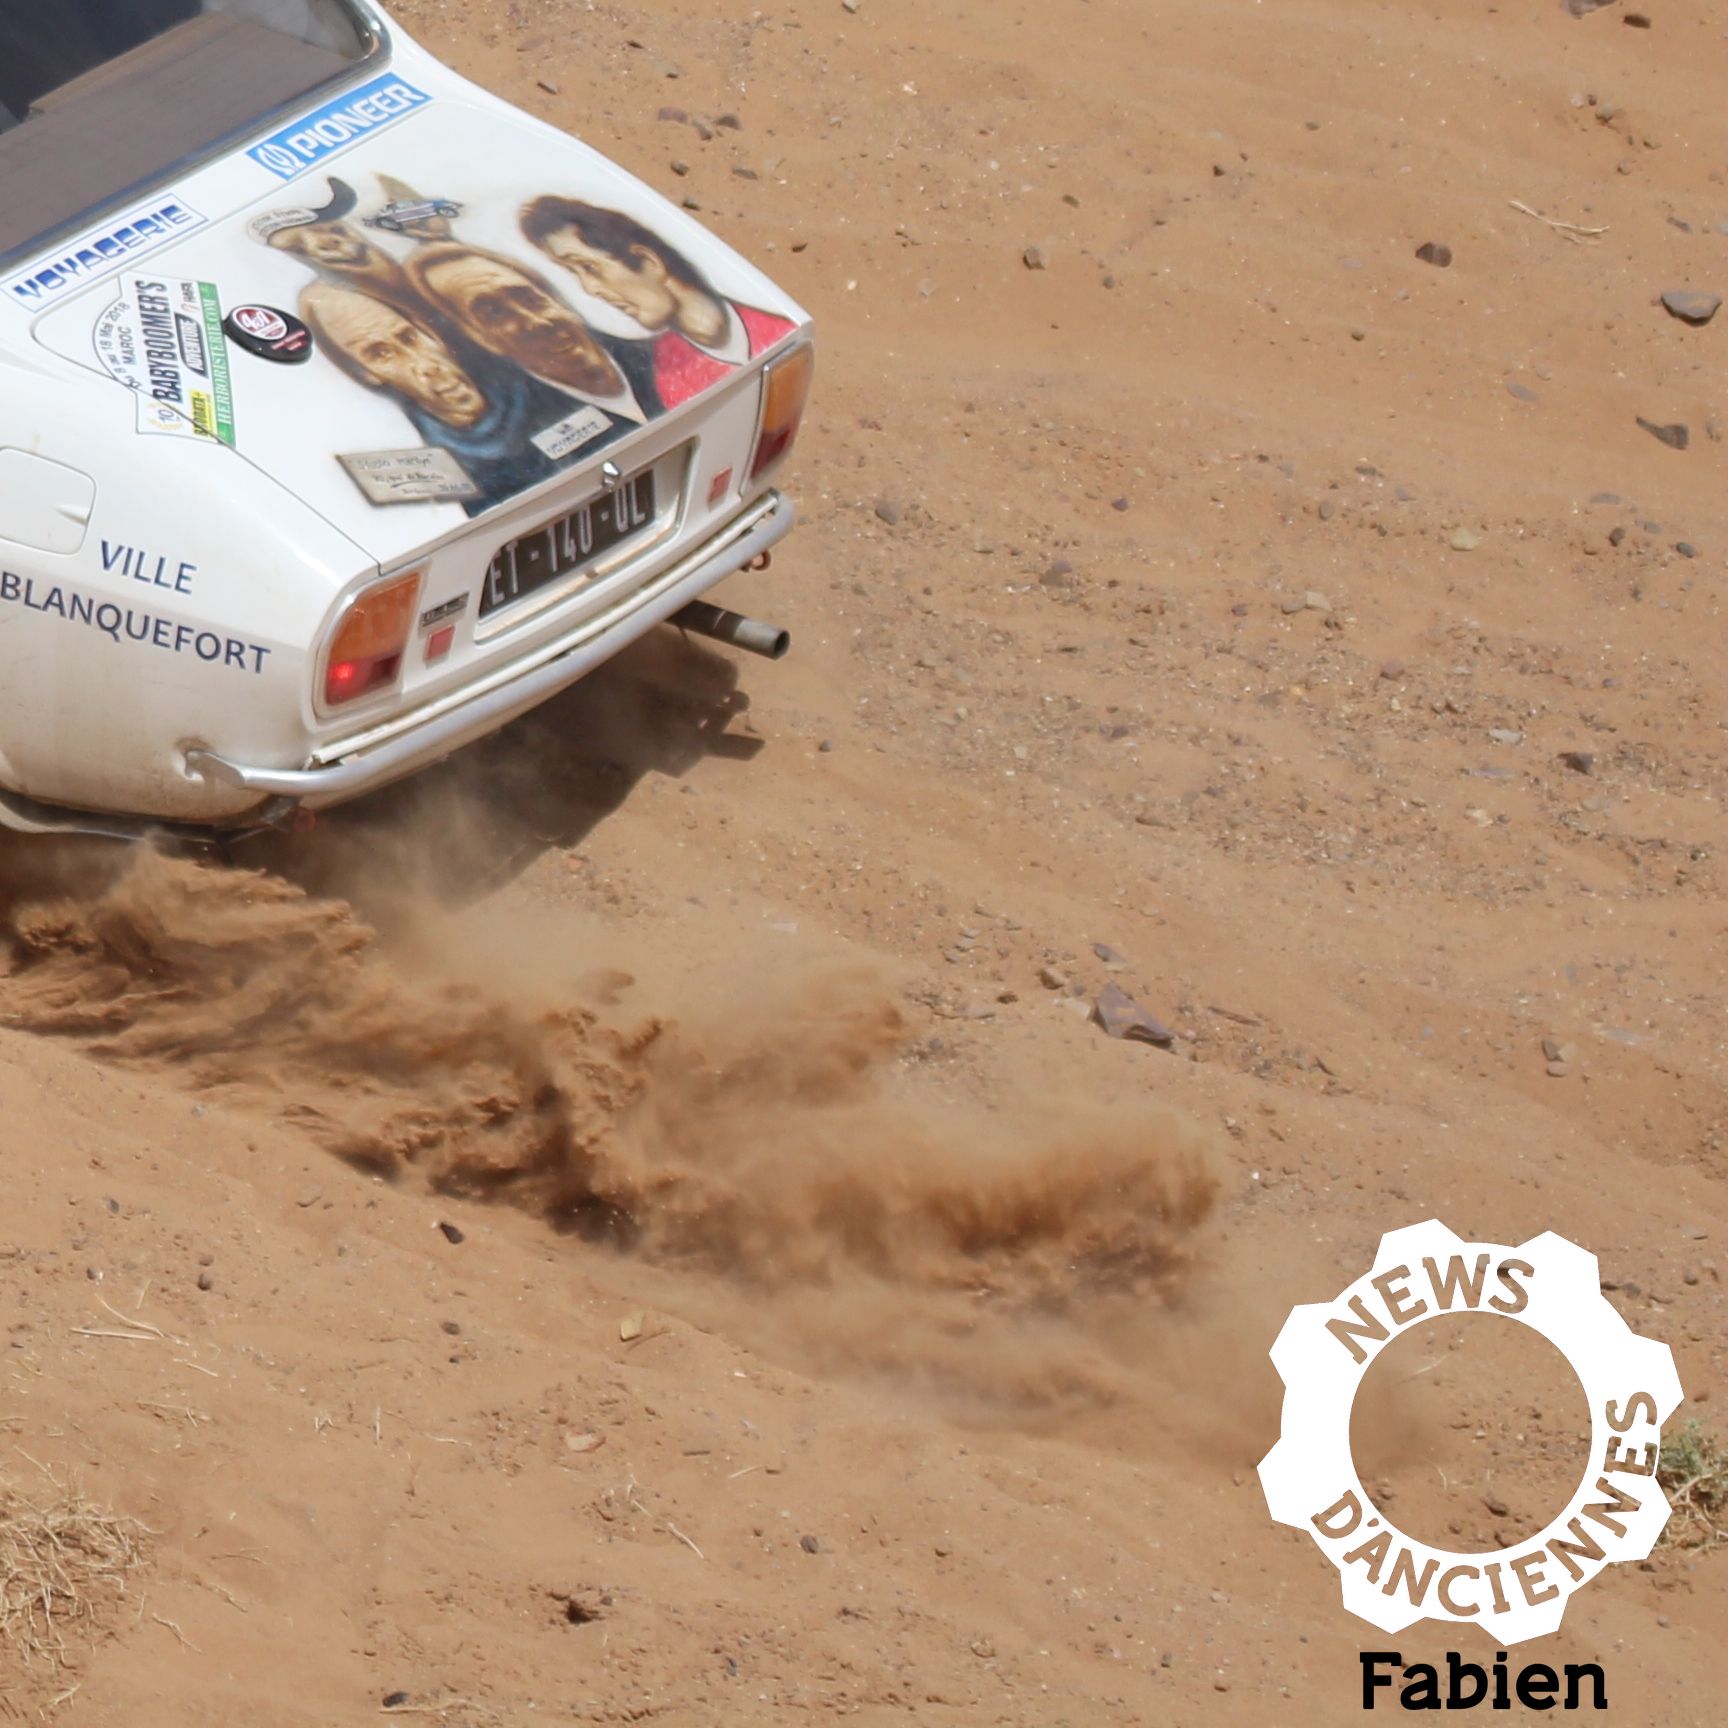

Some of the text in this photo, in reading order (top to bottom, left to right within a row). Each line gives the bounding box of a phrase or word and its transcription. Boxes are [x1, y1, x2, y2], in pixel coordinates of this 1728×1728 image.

[287, 82, 425, 159] PIONEER
[13, 203, 194, 300] VOYAGERIE
[99, 322, 113, 340] Mai
[103, 301, 131, 324] 2018
[100, 340, 113, 352] 18
[117, 325, 137, 366] MAROC
[134, 280, 184, 404] BABYBOOMER'S
[198, 298, 233, 426] HERBORISTERIE.COM
[158, 408, 175, 423] 10
[99, 540, 197, 596] VILLE
[0, 571, 271, 676] BLANQUEFORT
